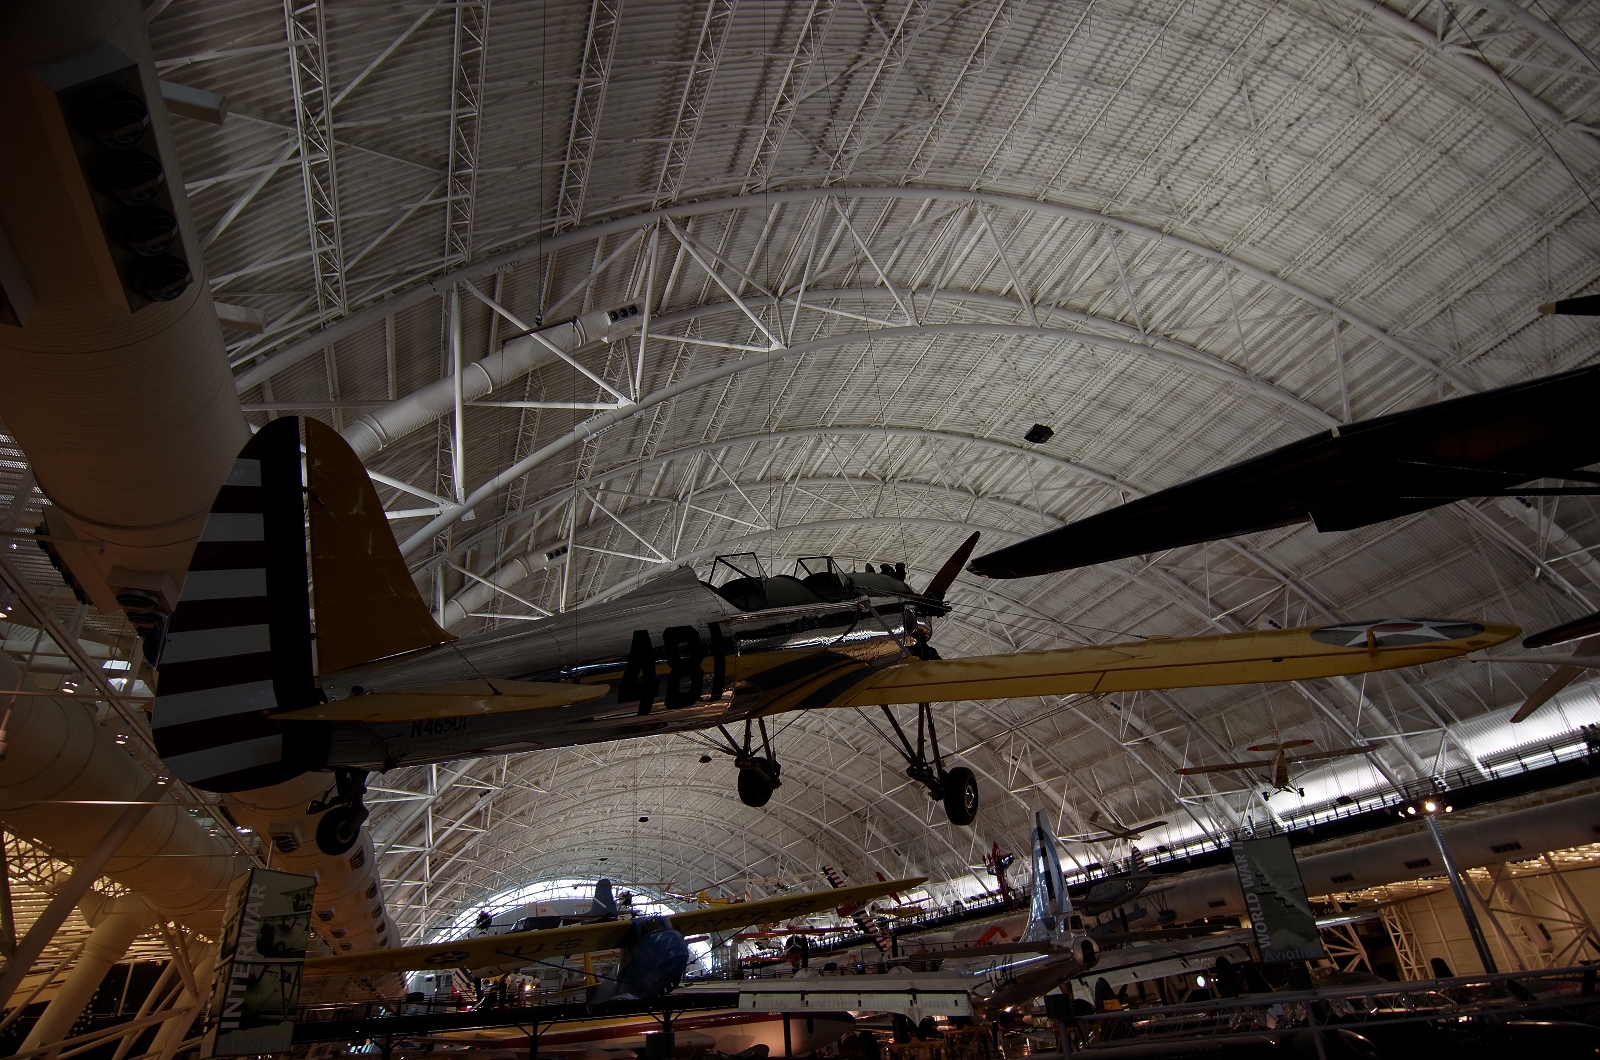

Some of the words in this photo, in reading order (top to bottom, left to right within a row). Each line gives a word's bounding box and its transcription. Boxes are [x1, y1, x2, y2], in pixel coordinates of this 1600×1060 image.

[618, 622, 726, 716] 481
[1235, 854, 1255, 888] WAR
[1246, 892, 1272, 949] WORLD
[220, 883, 267, 1029] INTERWAR
[1264, 949, 1325, 961] Aviation
